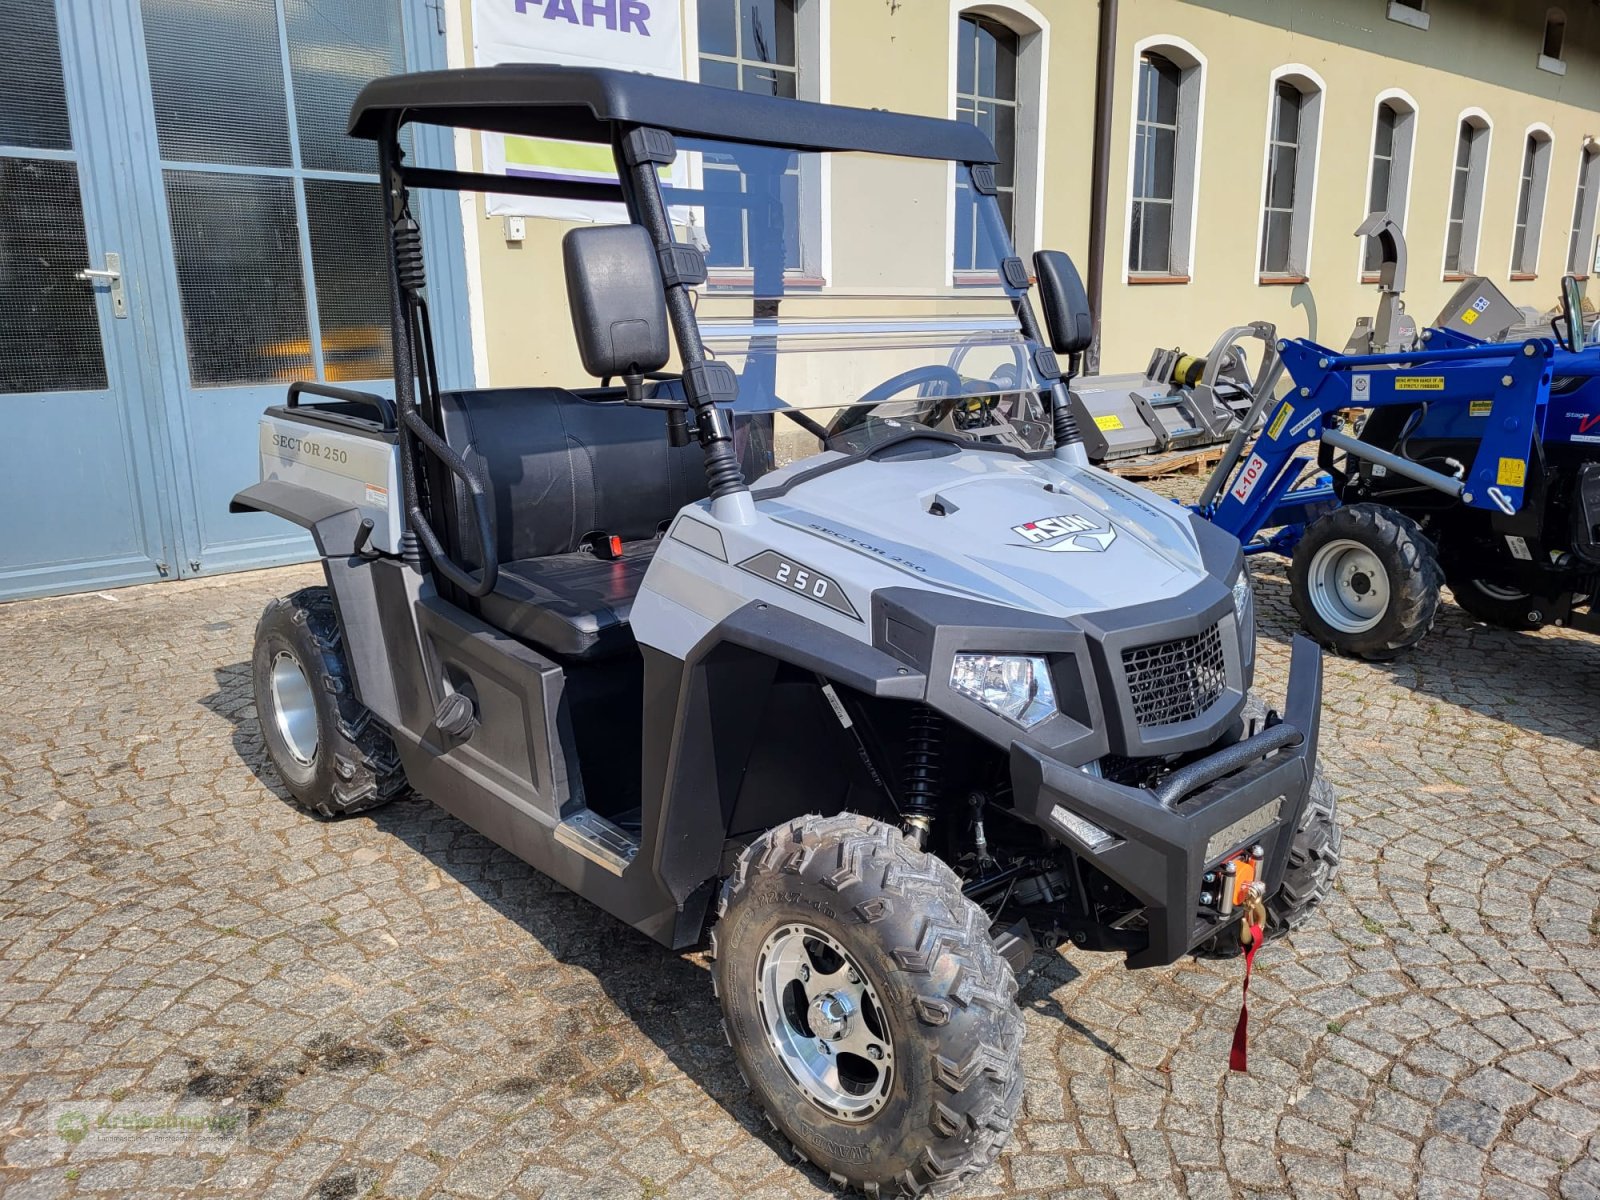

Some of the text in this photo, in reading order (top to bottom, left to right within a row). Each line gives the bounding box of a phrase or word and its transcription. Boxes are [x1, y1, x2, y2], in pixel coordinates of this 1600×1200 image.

[272, 434, 348, 464] SECTOR 250
[1010, 514, 1102, 544] HSUN
[807, 523, 927, 573] SECTOR 250
[775, 562, 828, 599] 250
[800, 1121, 864, 1159] WANDA
